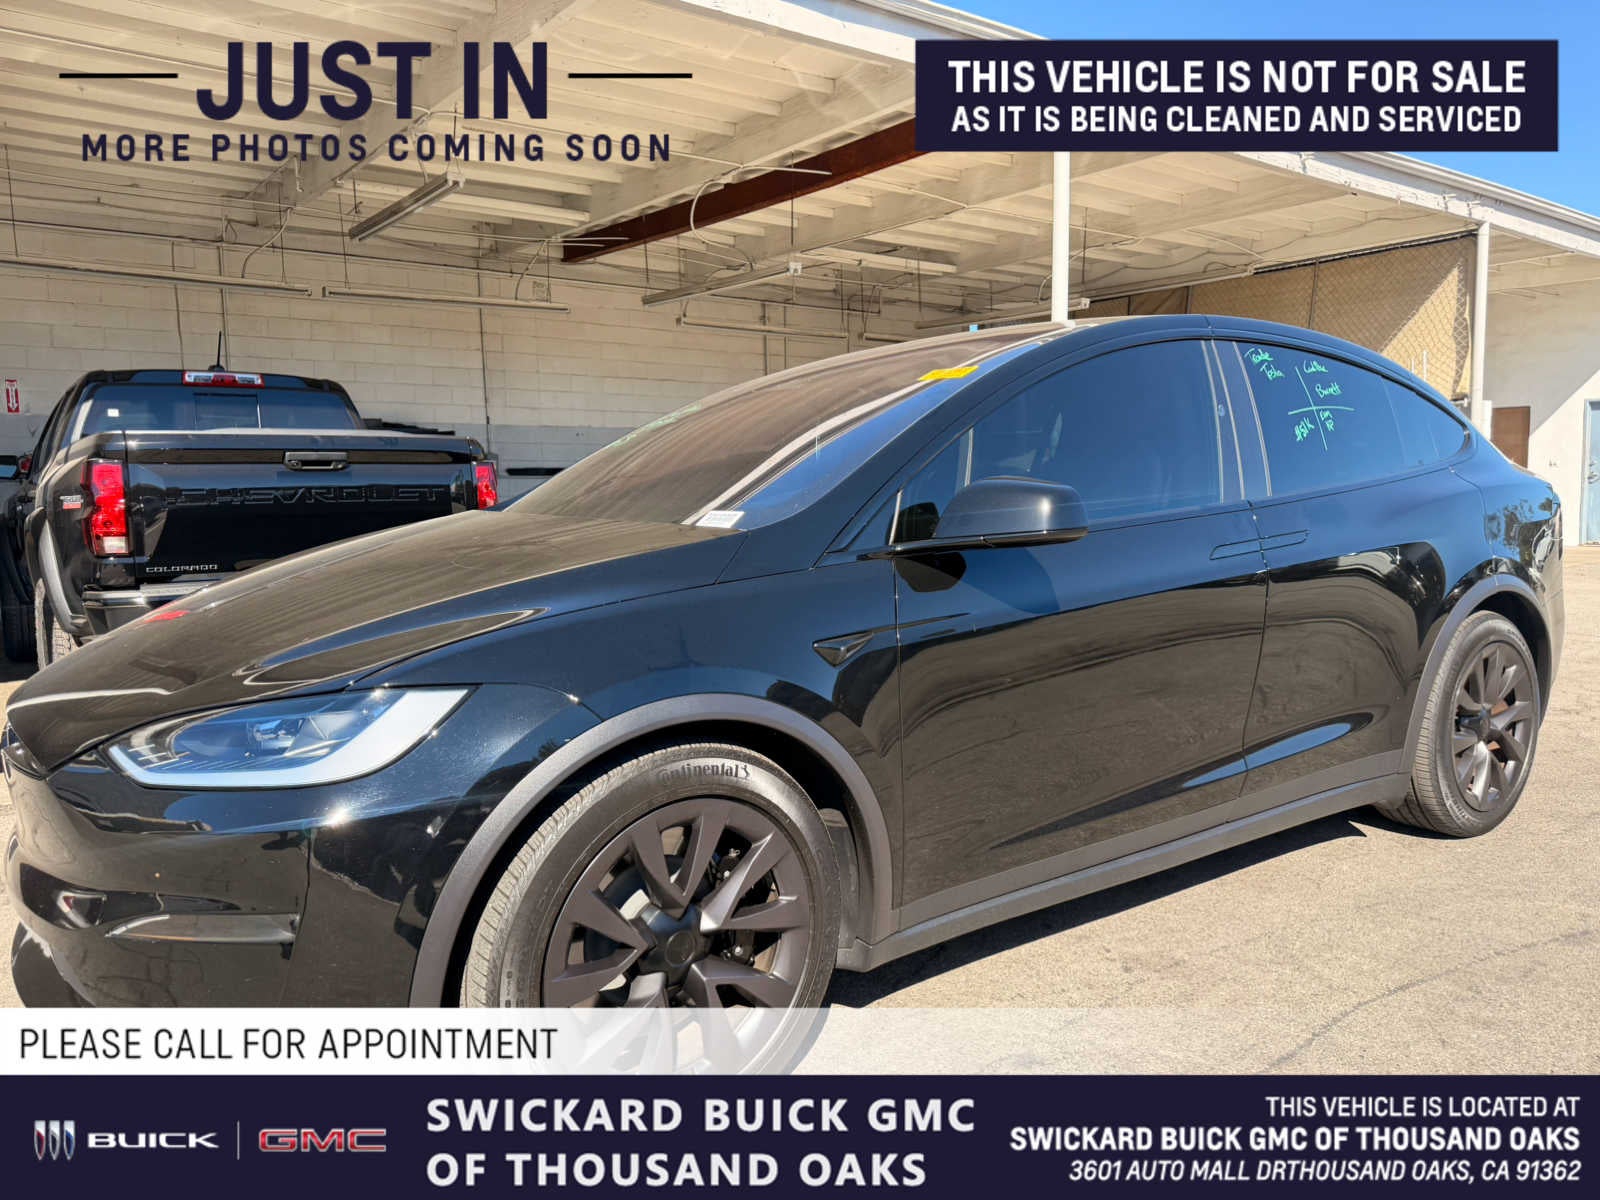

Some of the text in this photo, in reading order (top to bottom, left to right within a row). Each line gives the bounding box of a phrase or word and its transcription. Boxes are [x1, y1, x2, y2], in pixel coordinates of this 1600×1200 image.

[174, 487, 445, 505] CHEVROLET
[145, 564, 218, 573] COLORADO
[656, 763, 739, 781] Continental
